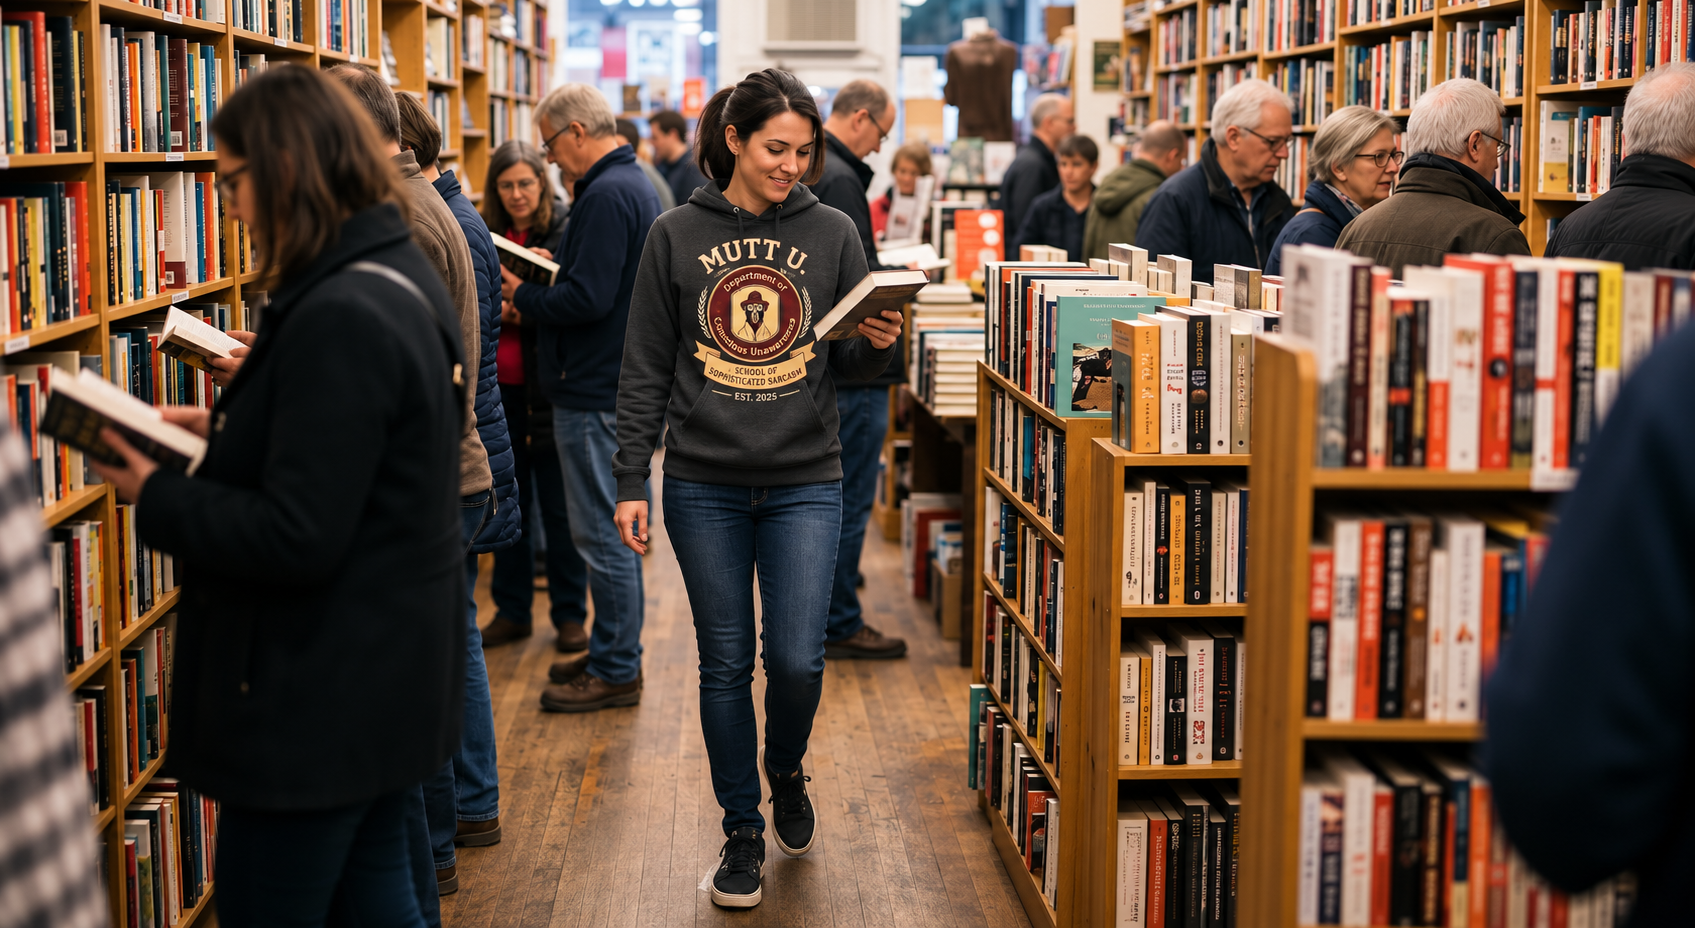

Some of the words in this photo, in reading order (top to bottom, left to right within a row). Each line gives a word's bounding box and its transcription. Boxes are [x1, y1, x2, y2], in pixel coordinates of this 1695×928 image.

[698, 238, 781, 274] MUTT
[787, 246, 808, 275] U.
[778, 281, 788, 291] of
[735, 366, 766, 376] SCHOOL
[767, 366, 778, 375] OF
[734, 392, 754, 402] EST.
[755, 392, 778, 402] 2025
